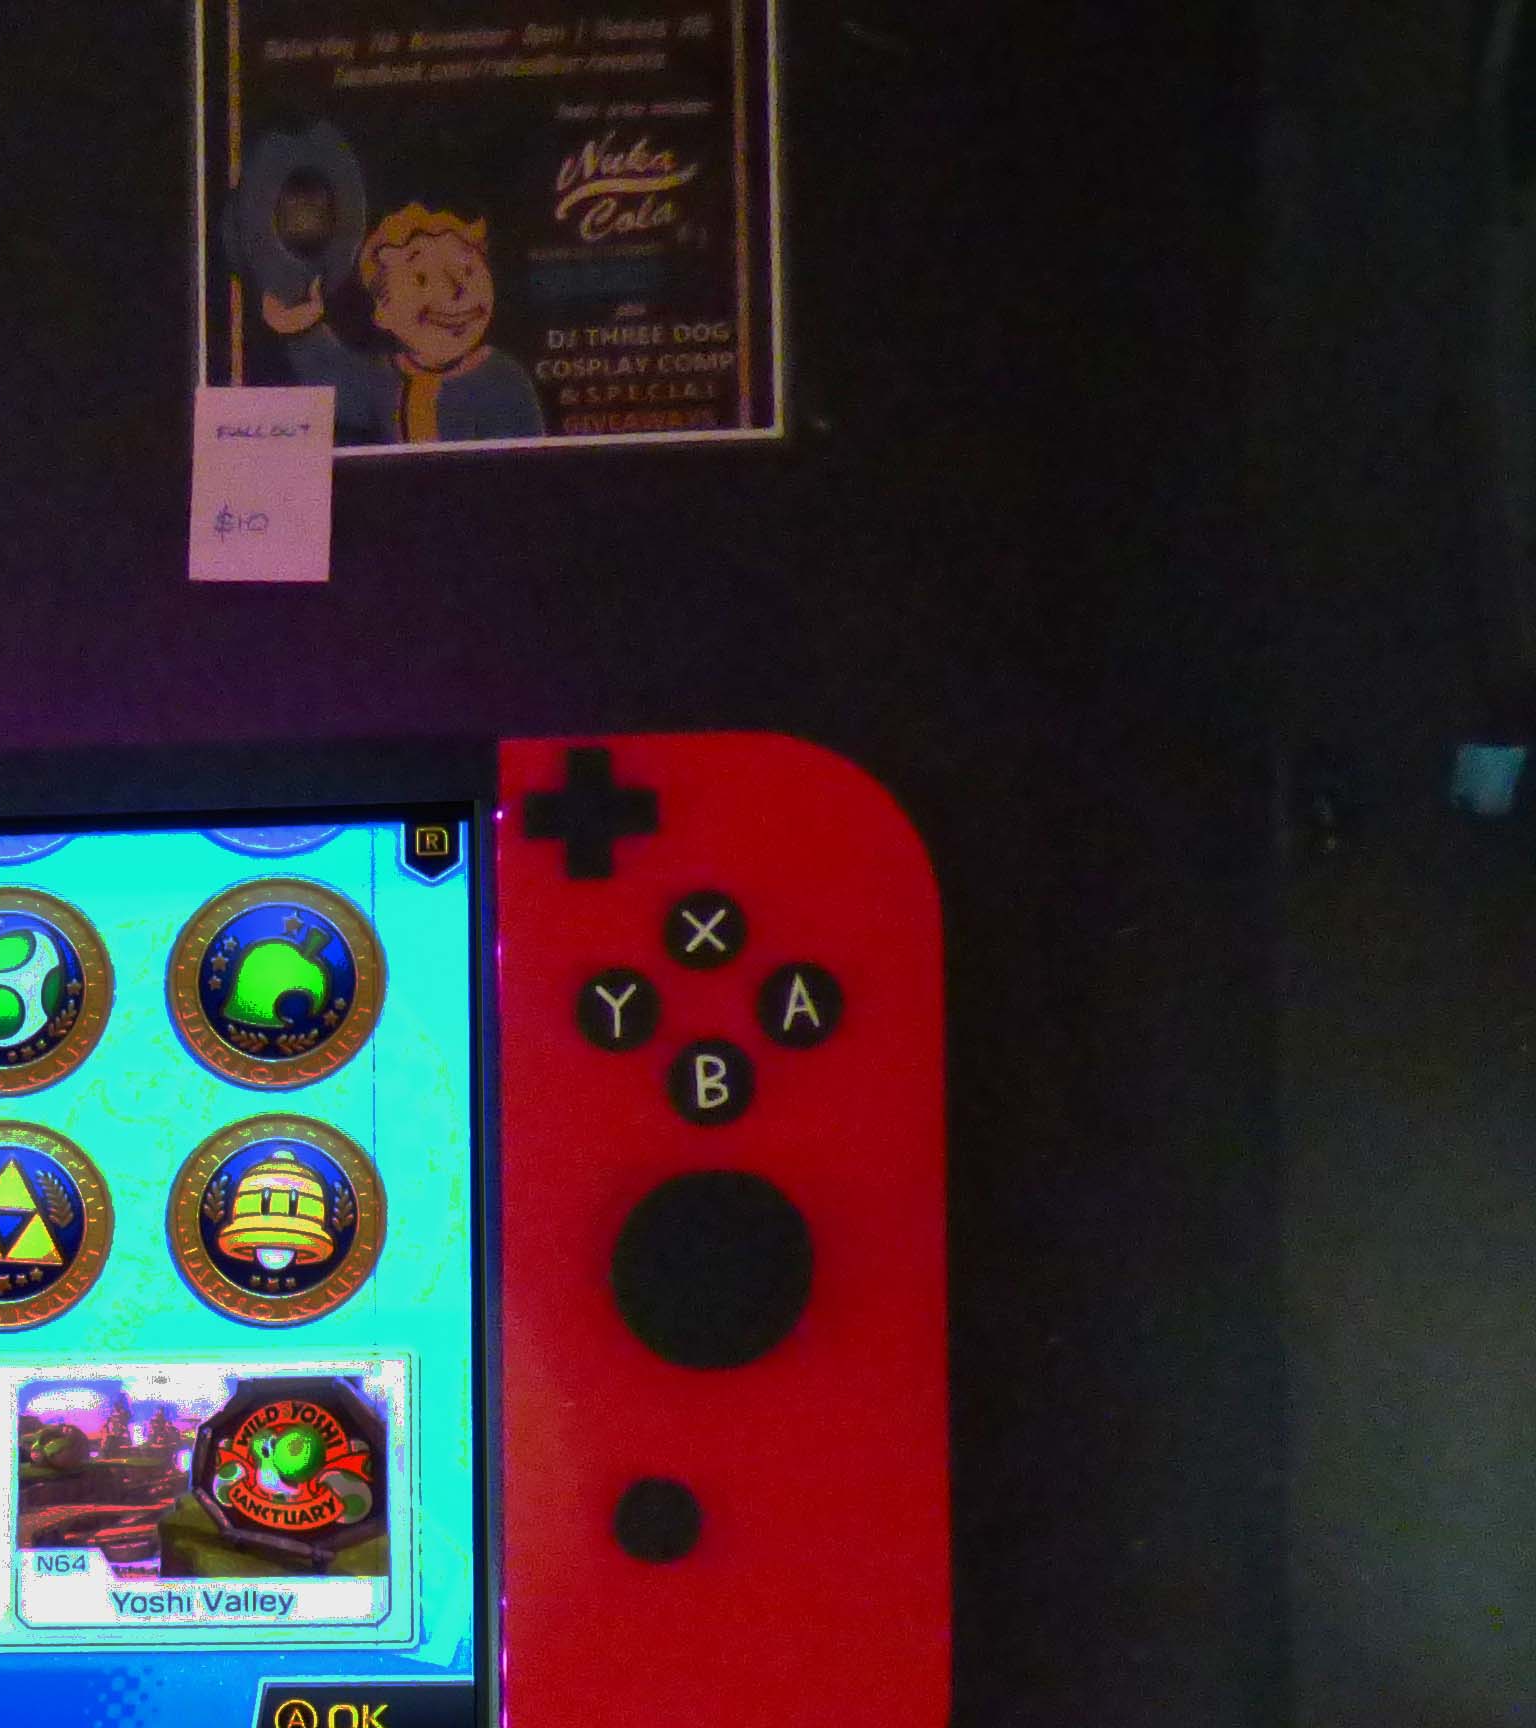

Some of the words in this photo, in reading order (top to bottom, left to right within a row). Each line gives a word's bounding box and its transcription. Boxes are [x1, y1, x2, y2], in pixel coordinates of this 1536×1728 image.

[681, 908, 727, 953] X
[595, 983, 638, 1040] Y
[782, 972, 821, 1032] A
[694, 1054, 730, 1110] B
[237, 1405, 279, 1447] WILD
[289, 1401, 344, 1448] YOSHI
[231, 1487, 337, 1525] SANCTUARY
[36, 1554, 87, 1574] N64
[111, 1590, 192, 1614] Yoshi
[201, 1589, 295, 1616] Valley
